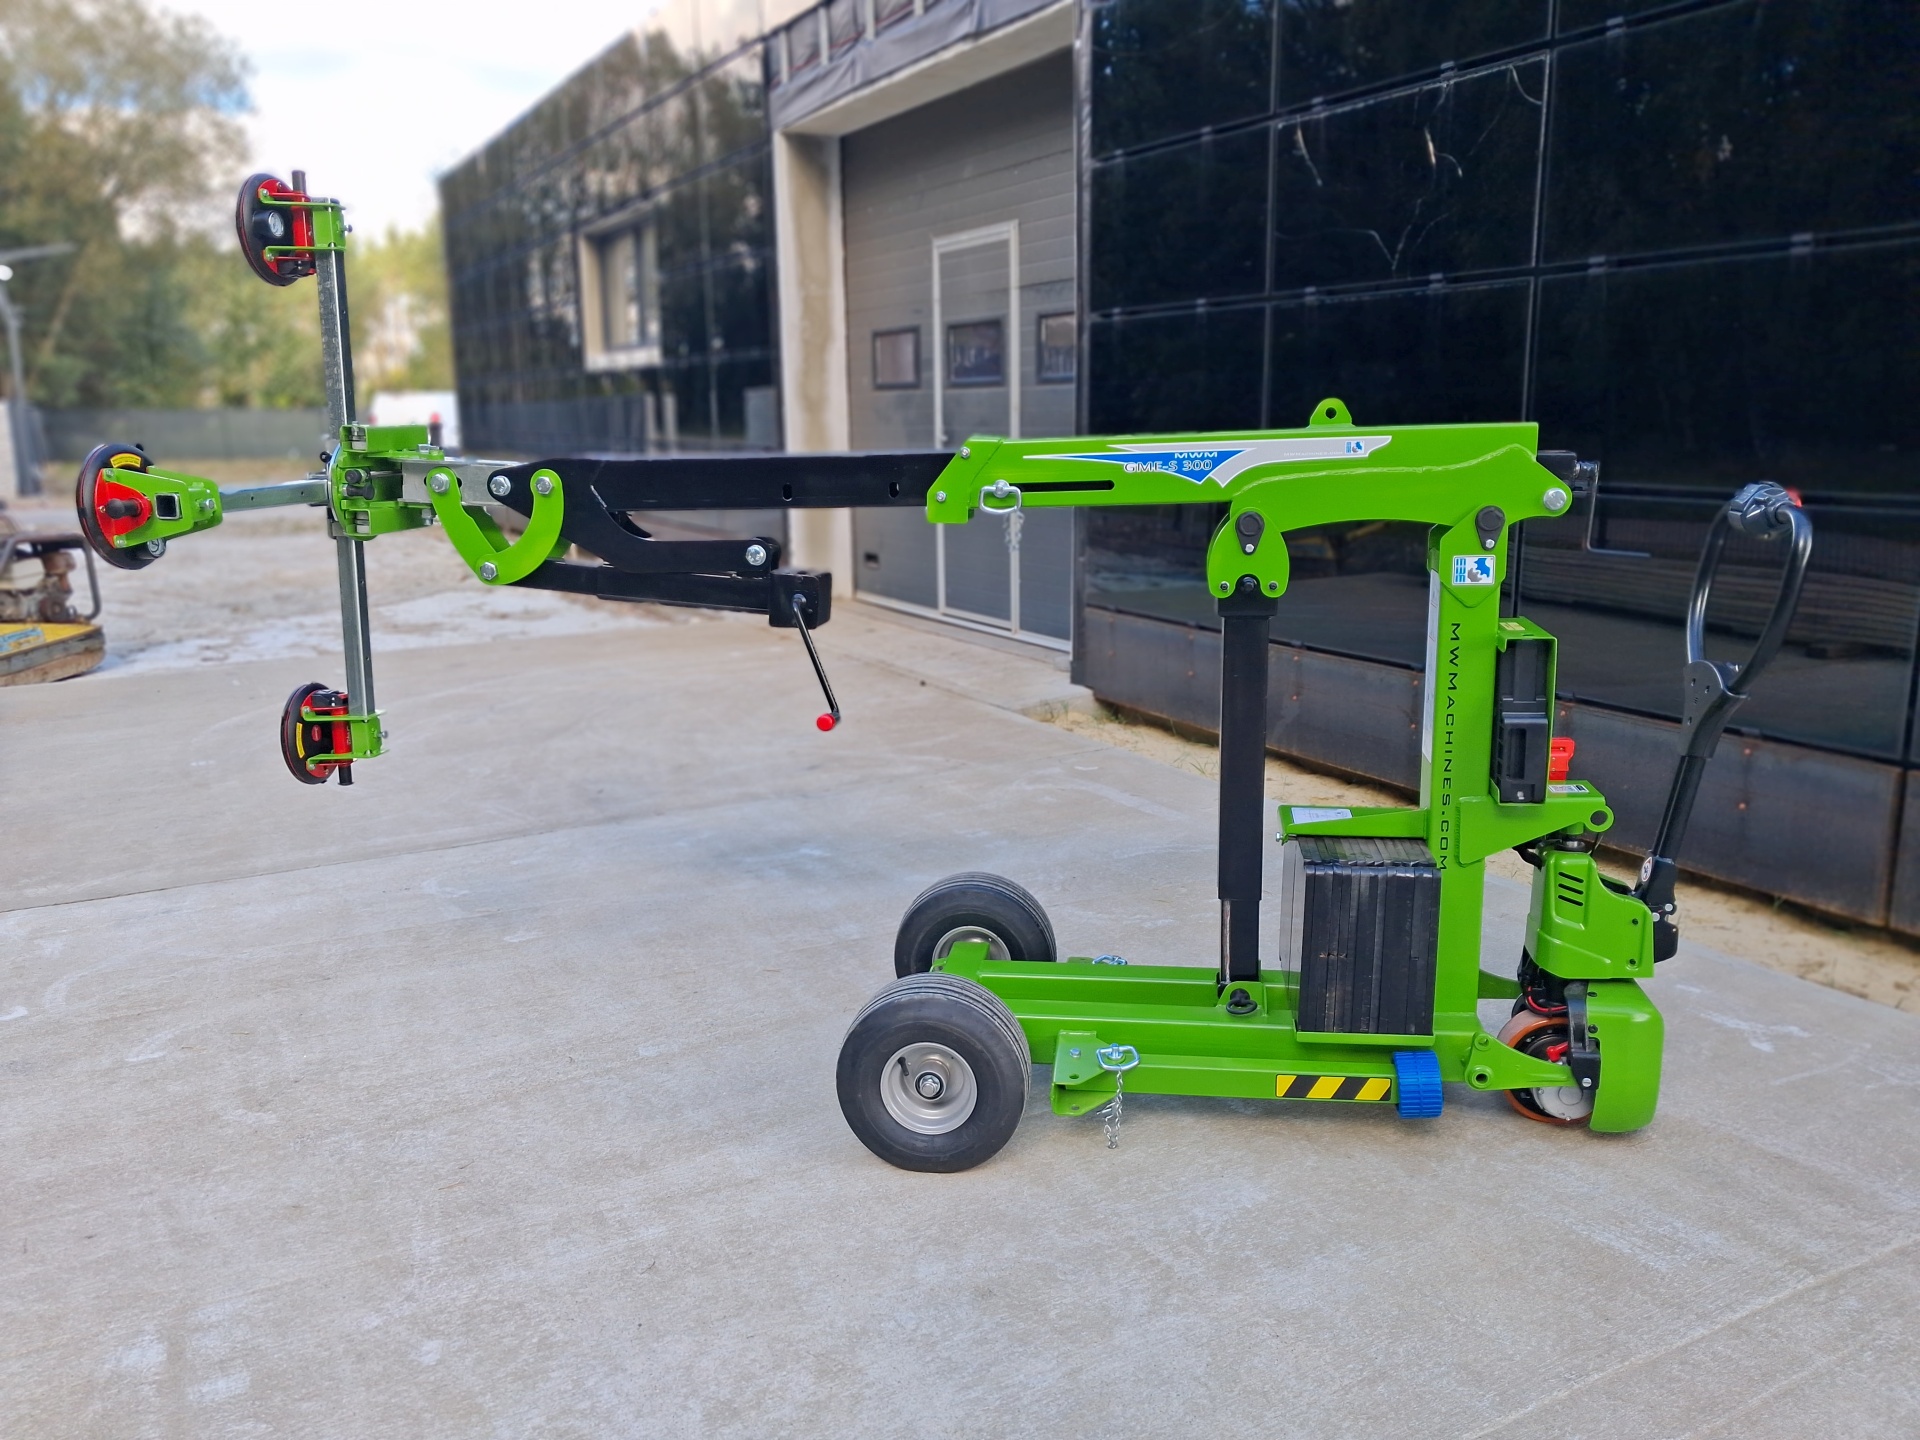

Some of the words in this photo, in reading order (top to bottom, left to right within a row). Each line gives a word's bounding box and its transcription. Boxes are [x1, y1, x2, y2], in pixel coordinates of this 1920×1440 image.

[1174, 451, 1218, 459] MWM
[1123, 460, 1179, 473] GME-S
[1182, 459, 1213, 472] 300
[1440, 623, 1461, 870] MWMACHINES.COM
